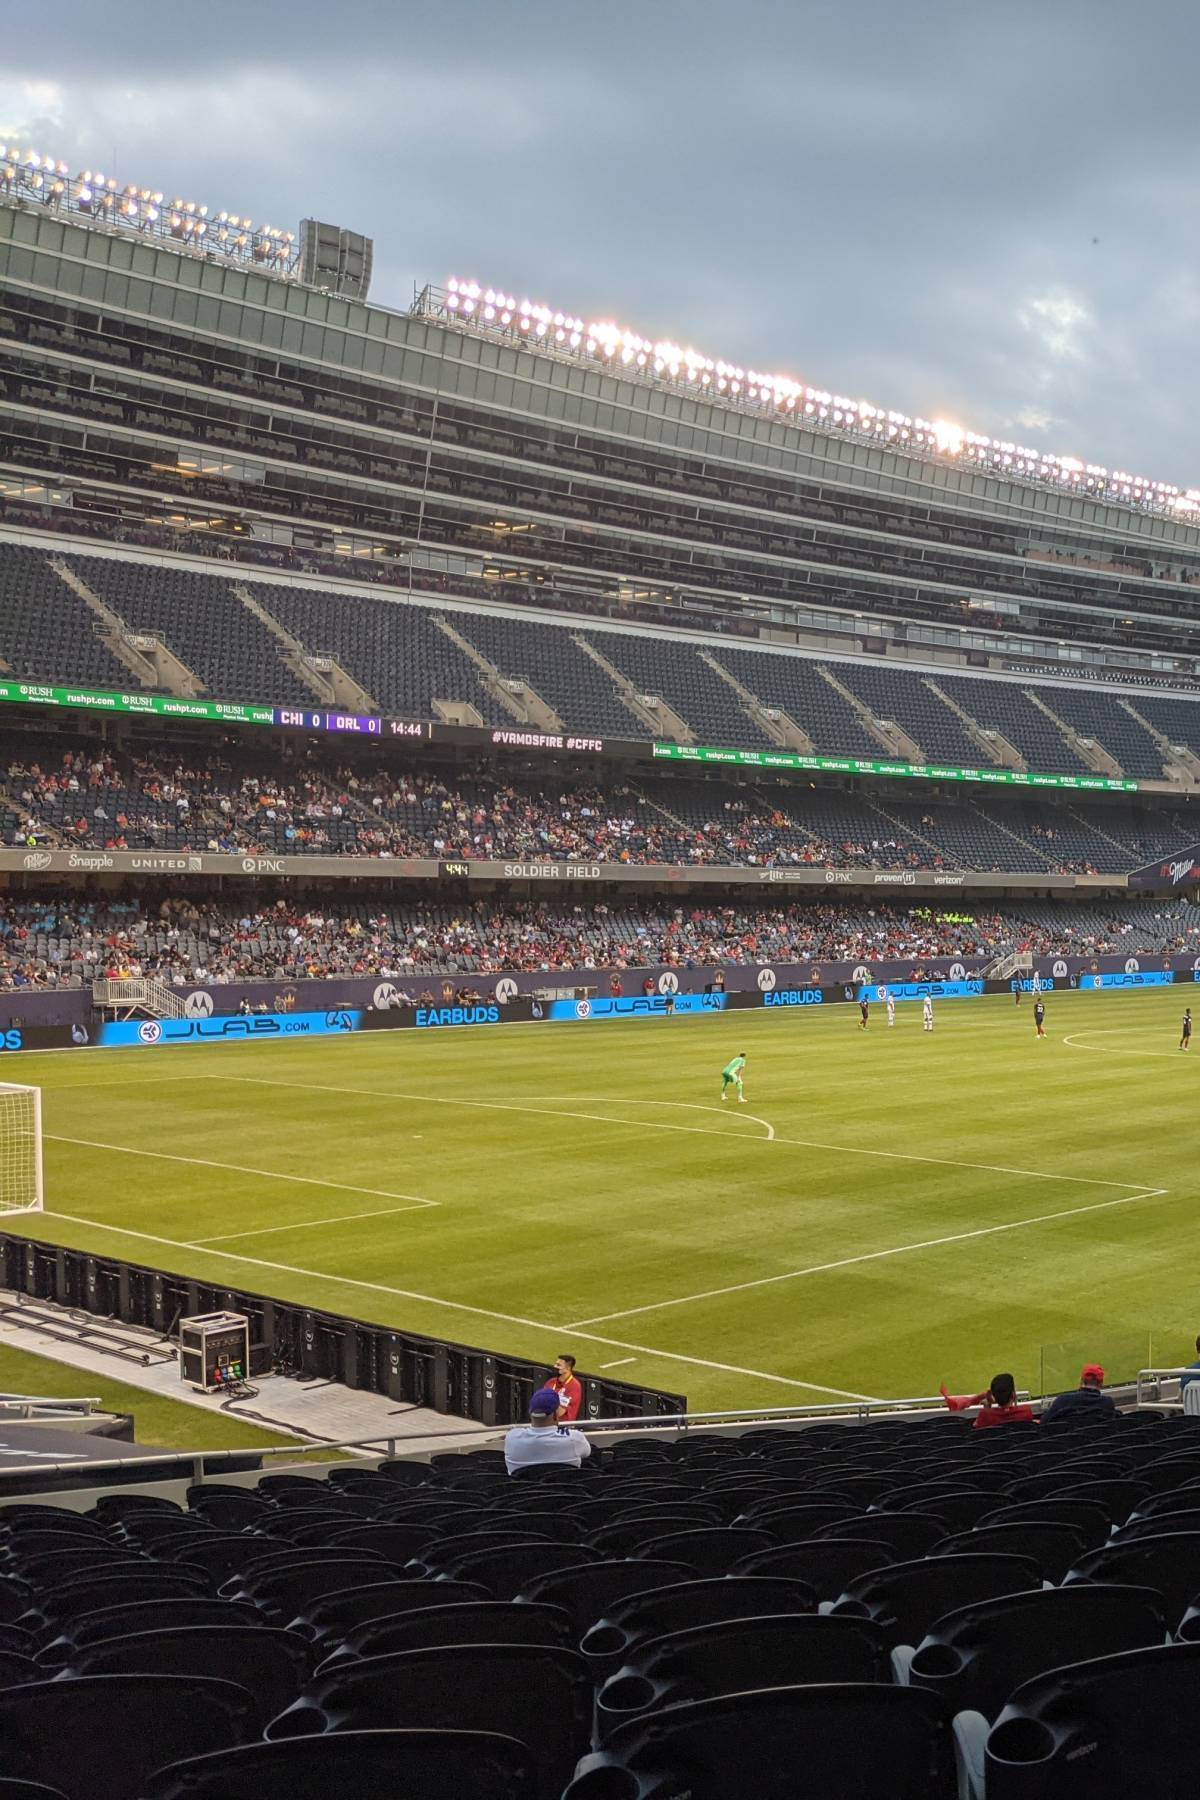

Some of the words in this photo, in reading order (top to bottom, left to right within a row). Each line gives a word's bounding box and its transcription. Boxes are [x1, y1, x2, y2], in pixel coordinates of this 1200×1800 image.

[29, 686, 53, 697] RUSH
[67, 694, 115, 706] rushpt.com
[130, 695, 153, 706] RUSH
[164, 702, 208, 715] rushpt.com
[223, 705, 245, 715] RUSH
[281, 711, 304, 725] CHI
[312, 714, 320, 727] 0
[336, 717, 361, 730] ORL
[368, 719, 376, 732] 0
[390, 722, 422, 736] 14:44
[566, 738, 603, 751] #CFFC
[69, 853, 113, 870] Snapple
[132, 859, 186, 868] UNITED
[258, 860, 285, 871] PNC
[504, 865, 559, 877] SOLDIER
[566, 866, 600, 878] FIELD
[835, 873, 853, 882] PNC
[874, 874, 903, 884] proven
[934, 876, 964, 885] verizon
[764, 989, 822, 1006] EARBUDS
[415, 1006, 499, 1027] EARBUDS
